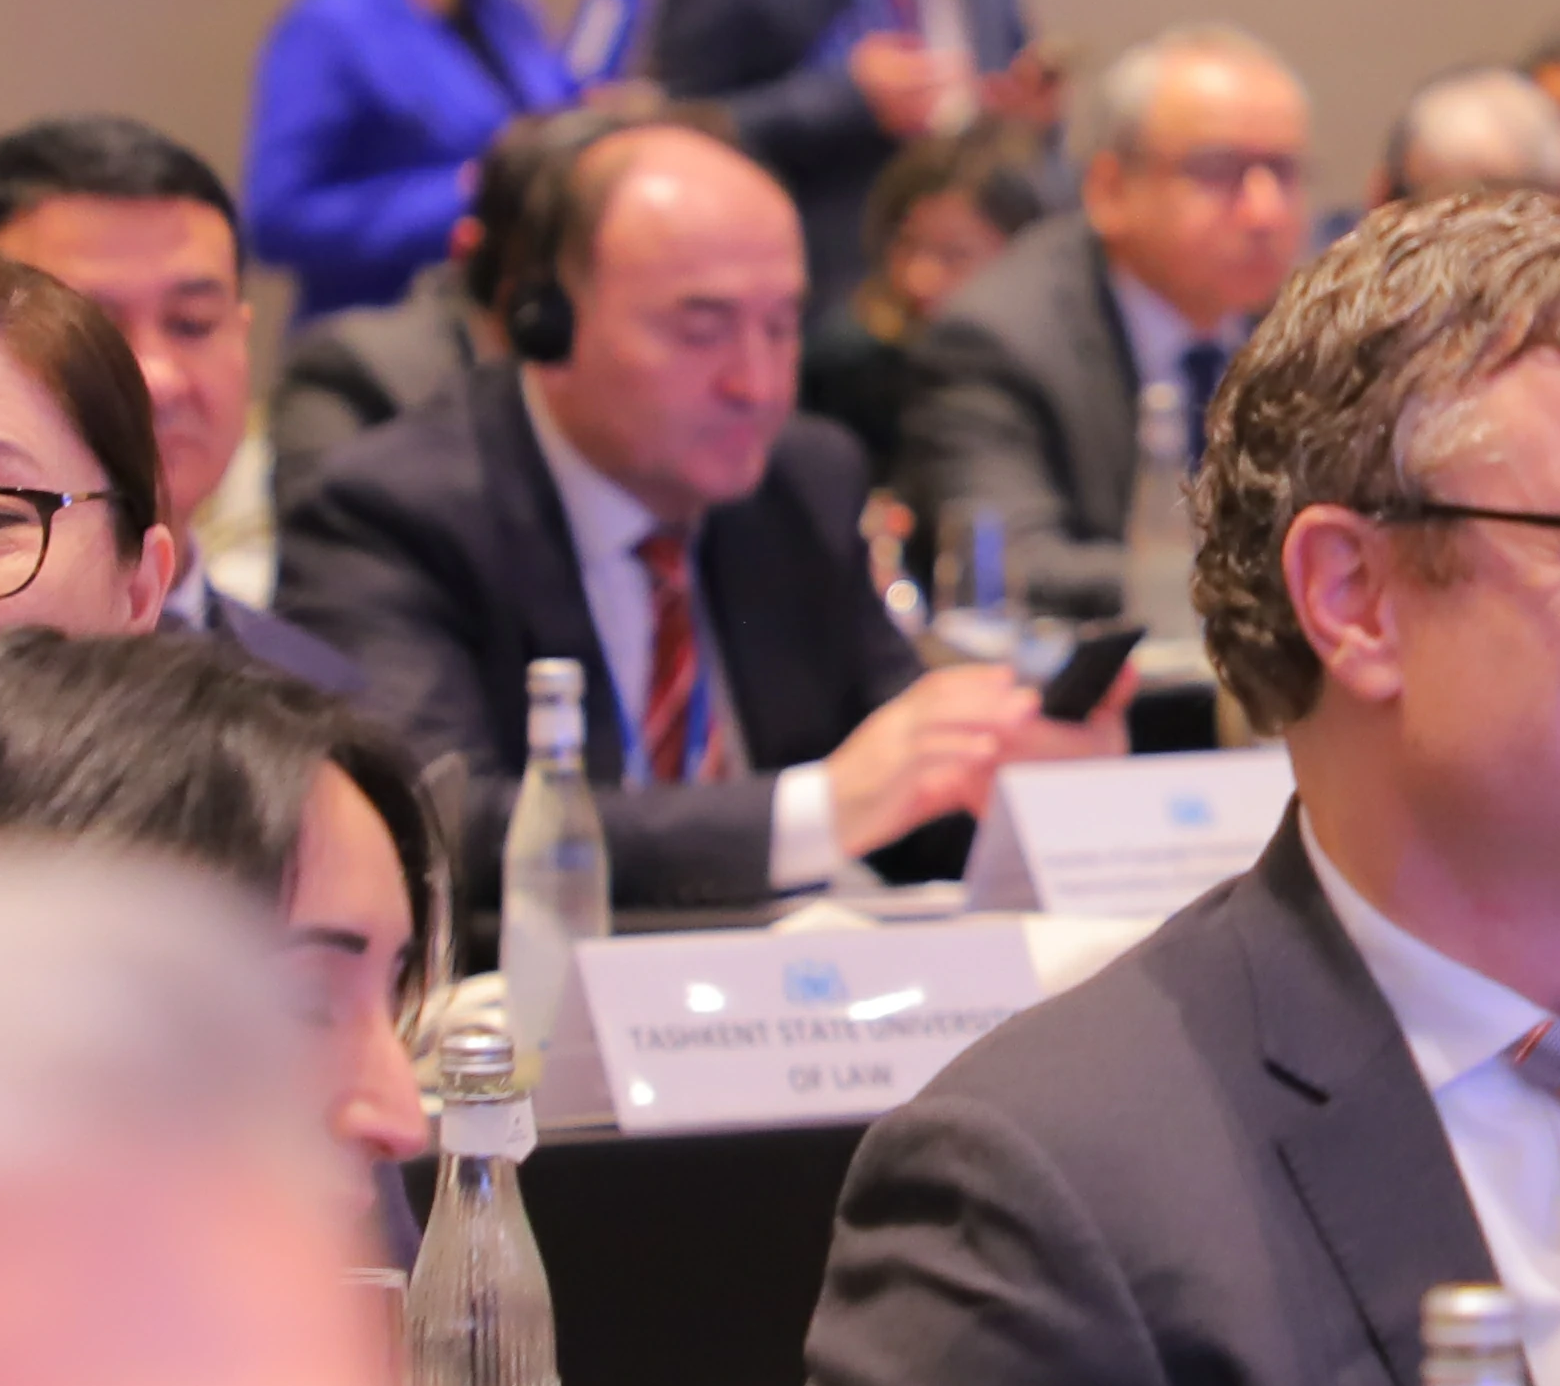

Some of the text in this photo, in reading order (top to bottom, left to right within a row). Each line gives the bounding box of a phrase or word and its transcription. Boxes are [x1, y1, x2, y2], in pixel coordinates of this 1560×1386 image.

[629, 1005, 1016, 1051] TASHKENT STATE UNIVERSIT
[787, 1061, 892, 1095] OF LAW
